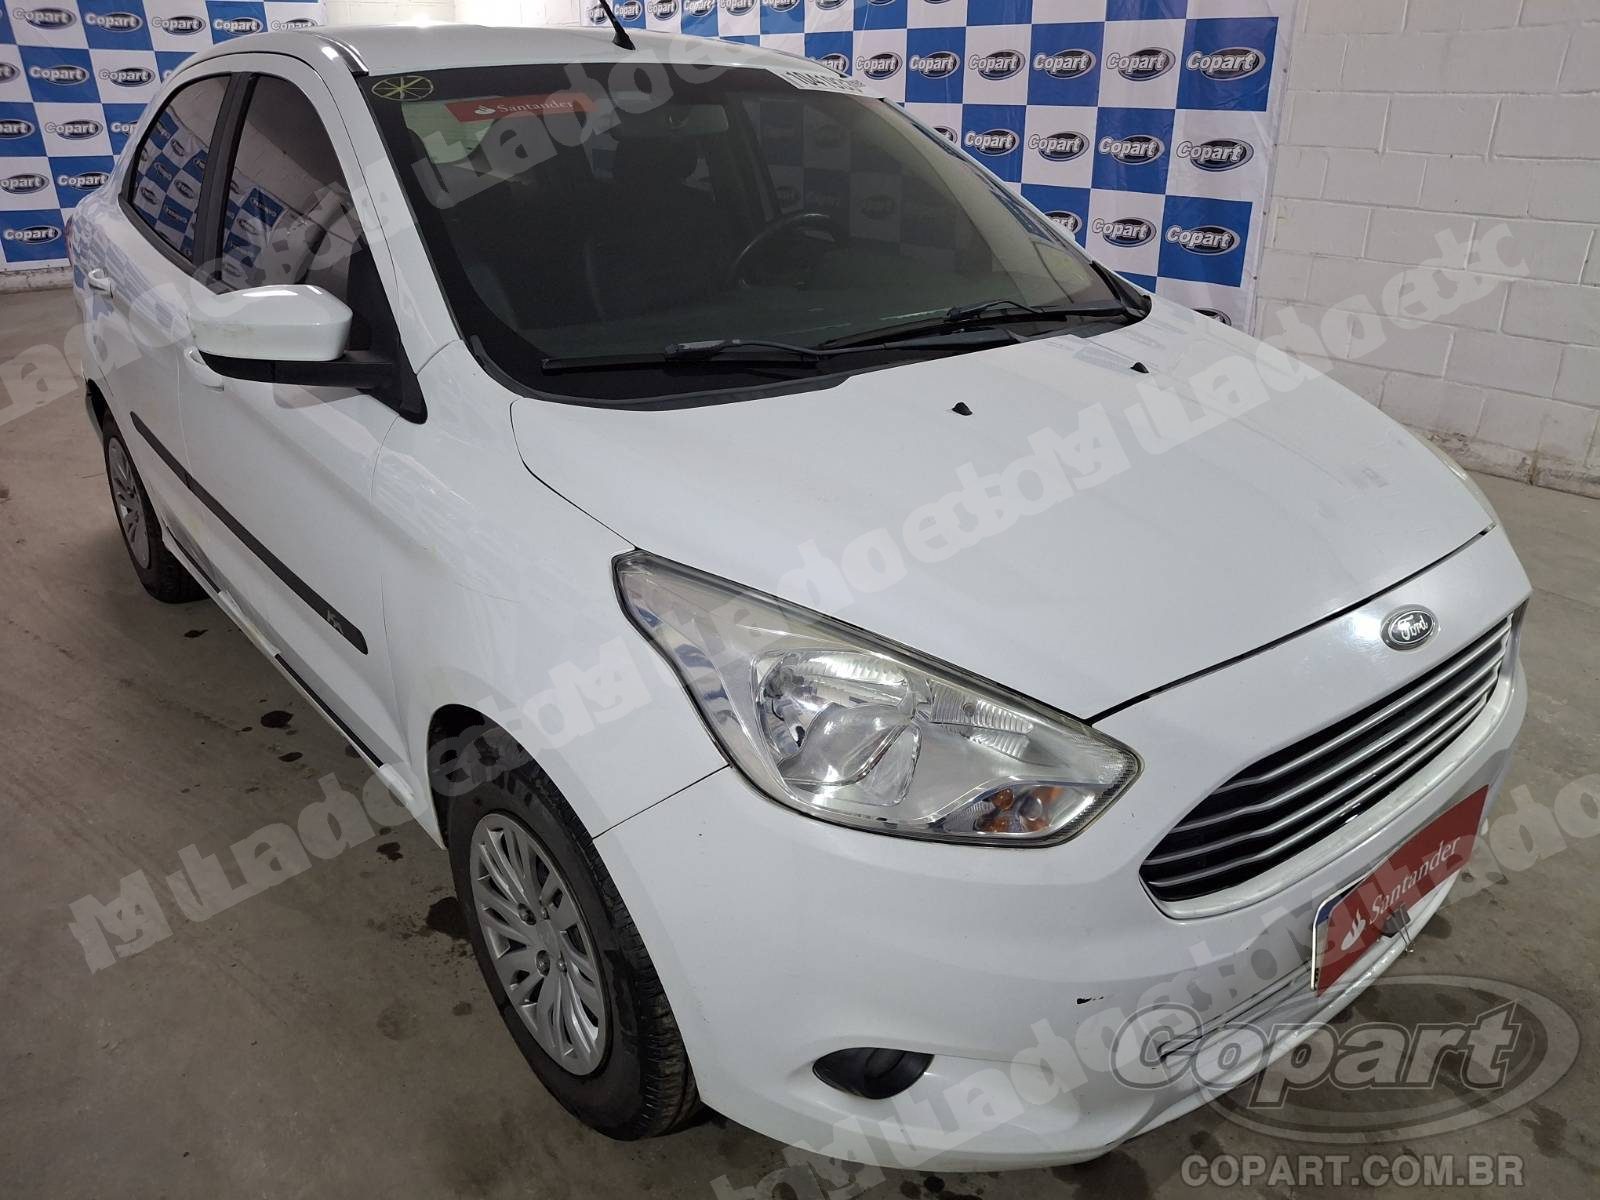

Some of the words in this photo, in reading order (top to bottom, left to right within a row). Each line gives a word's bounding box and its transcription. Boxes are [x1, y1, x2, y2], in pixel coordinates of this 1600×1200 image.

[613, 3, 640, 16] Copart
[647, 1, 675, 14] Copart
[13, 8, 69, 25] Copart
[85, 13, 137, 28] Copart
[152, 17, 199, 31] Copart
[213, 18, 258, 32] Copart
[856, 55, 896, 72] Copart
[909, 55, 954, 73] Copart
[968, 53, 1018, 73] Copart
[1034, 53, 1087, 74] Copart
[1106, 51, 1166, 75] Copart
[1187, 50, 1254, 75] Copart
[30, 66, 83, 81] Copart
[100, 70, 148, 82] Copart
[45, 121, 95, 136] Copart
[965, 130, 1015, 151] Copart
[1028, 134, 1081, 155] Copart
[1099, 136, 1156, 159] Copart
[1177, 141, 1241, 166] Copart
[0, 176, 41, 190] opart
[58, 174, 107, 189] Copart
[4, 227, 55, 241] Copart
[1092, 218, 1147, 242] Copart
[1166, 226, 1231, 251] Copart
[1398, 615, 1428, 640] Ford
[1369, 836, 1460, 924] Santander
